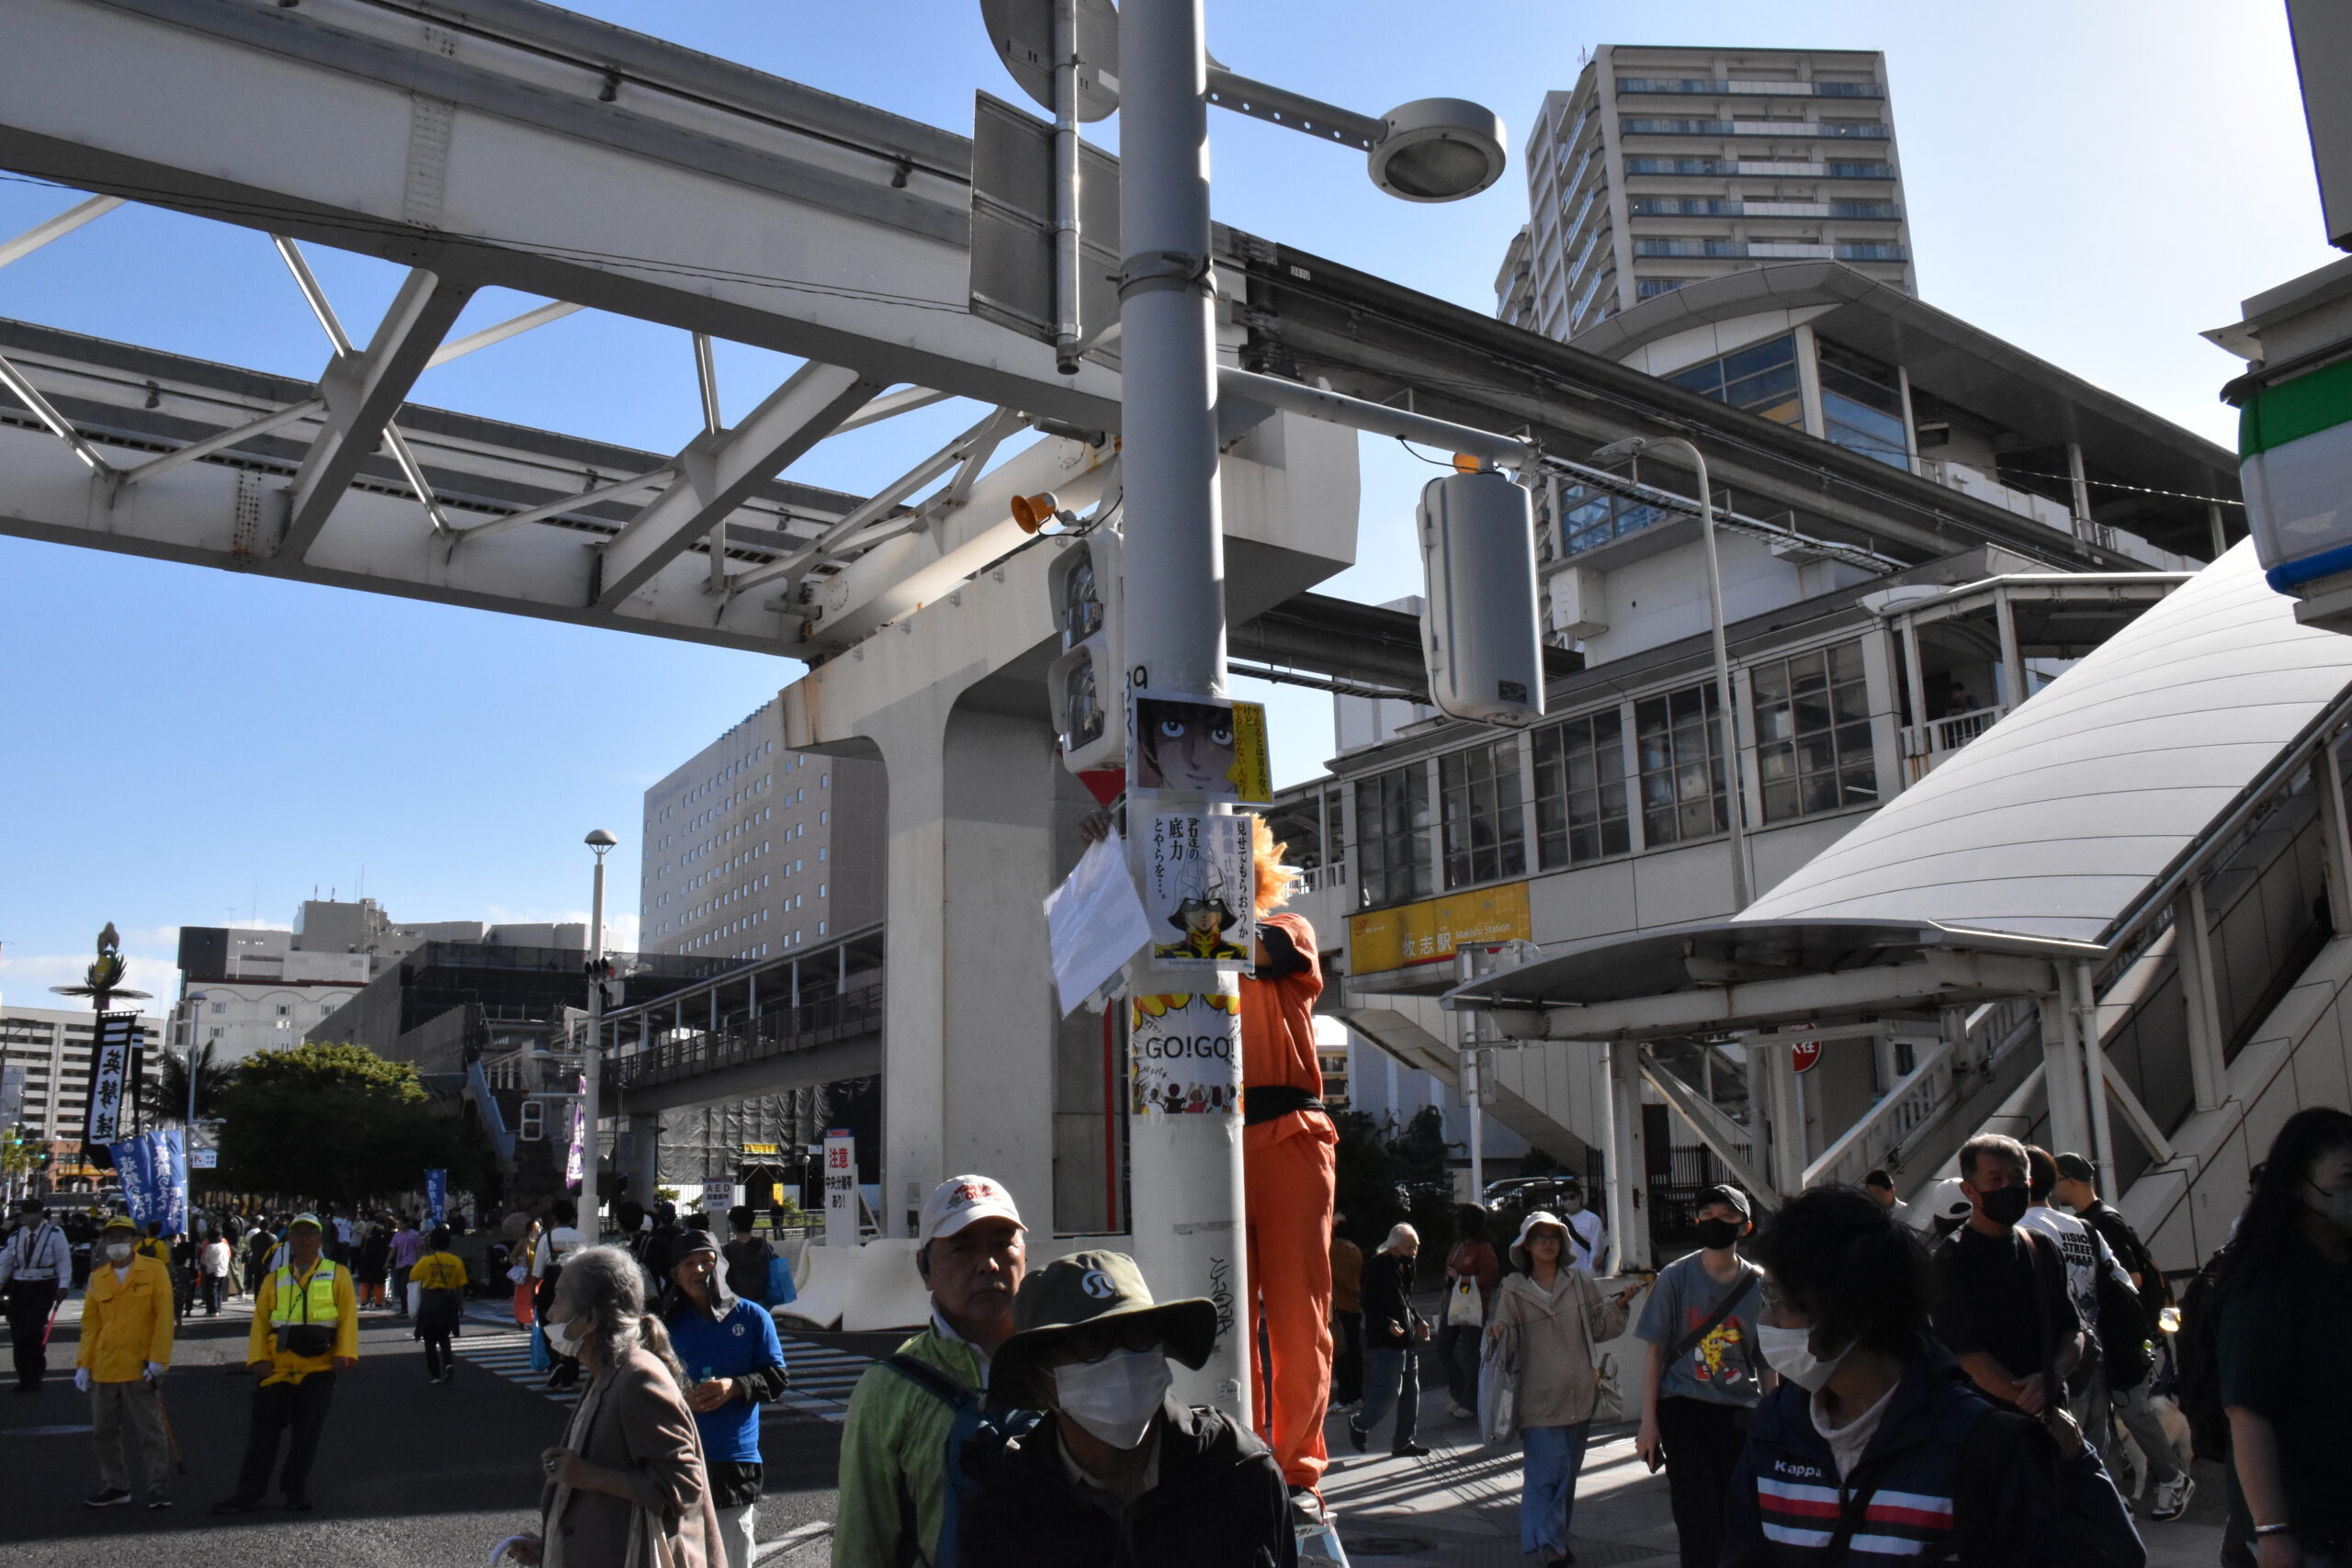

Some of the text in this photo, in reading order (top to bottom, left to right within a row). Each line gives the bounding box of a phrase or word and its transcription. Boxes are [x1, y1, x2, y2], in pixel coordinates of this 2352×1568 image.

[1169, 817, 1183, 861] 底力
[1237, 820, 1249, 939] 見せてもらおうか
[1455, 926, 1483, 940] Makishi
[1484, 922, 1511, 935] Station
[1402, 931, 1452, 958] 牧志駅
[1146, 1035, 1235, 1059] GO!GO!
[829, 1147, 848, 1168] 注意
[707, 1183, 730, 1192] AED
[826, 1175, 853, 1190] 中央分離帯
[1774, 1461, 1822, 1477] Kappa
